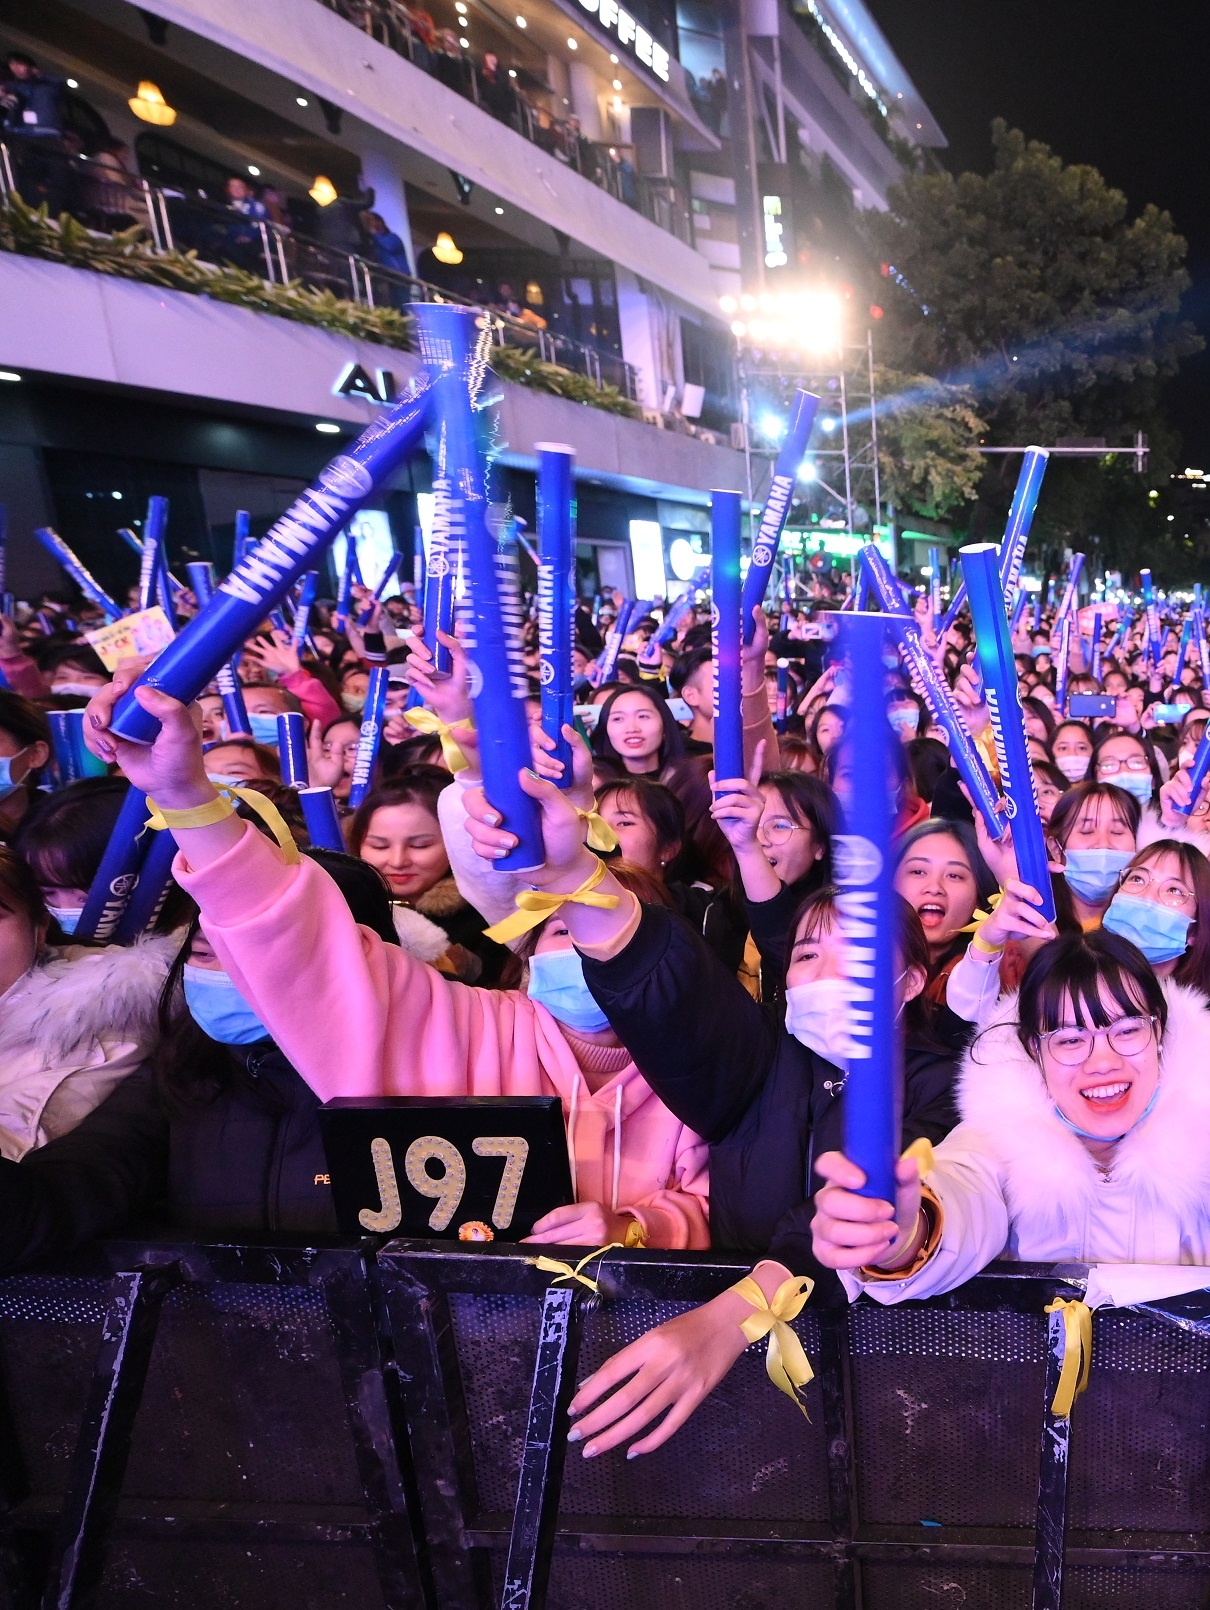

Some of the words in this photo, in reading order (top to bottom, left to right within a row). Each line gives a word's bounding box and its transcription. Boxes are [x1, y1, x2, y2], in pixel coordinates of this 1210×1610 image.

[217, 487, 349, 606] YAMAHA
[430, 478, 453, 553] YAMAHA
[757, 474, 793, 546] YAMAHA
[351, 733, 379, 786] YAMAHA
[358, 1135, 530, 1233] J97
